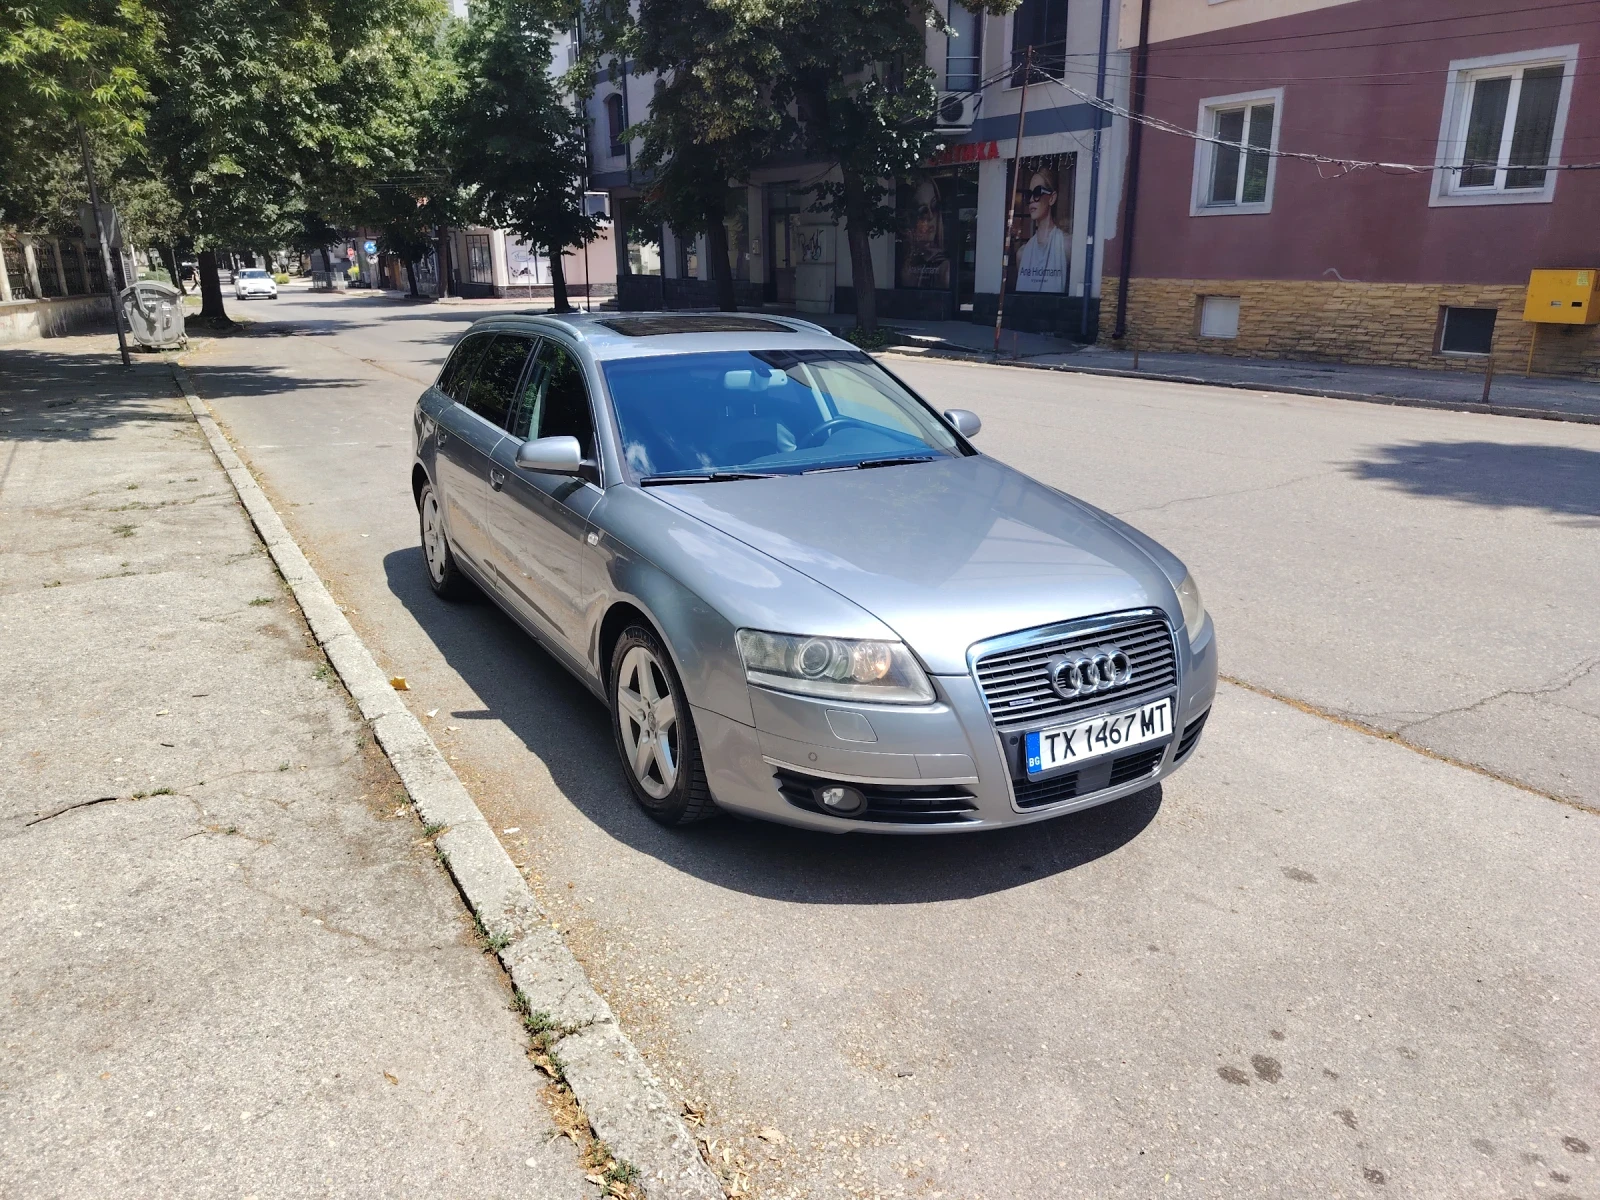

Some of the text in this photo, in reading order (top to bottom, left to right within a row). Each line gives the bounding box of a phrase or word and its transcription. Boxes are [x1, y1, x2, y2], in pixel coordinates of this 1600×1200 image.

[1020, 266, 1031, 276] Ana
[1045, 703, 1167, 763] TX 1467 MT
[1029, 756, 1041, 767] BG
